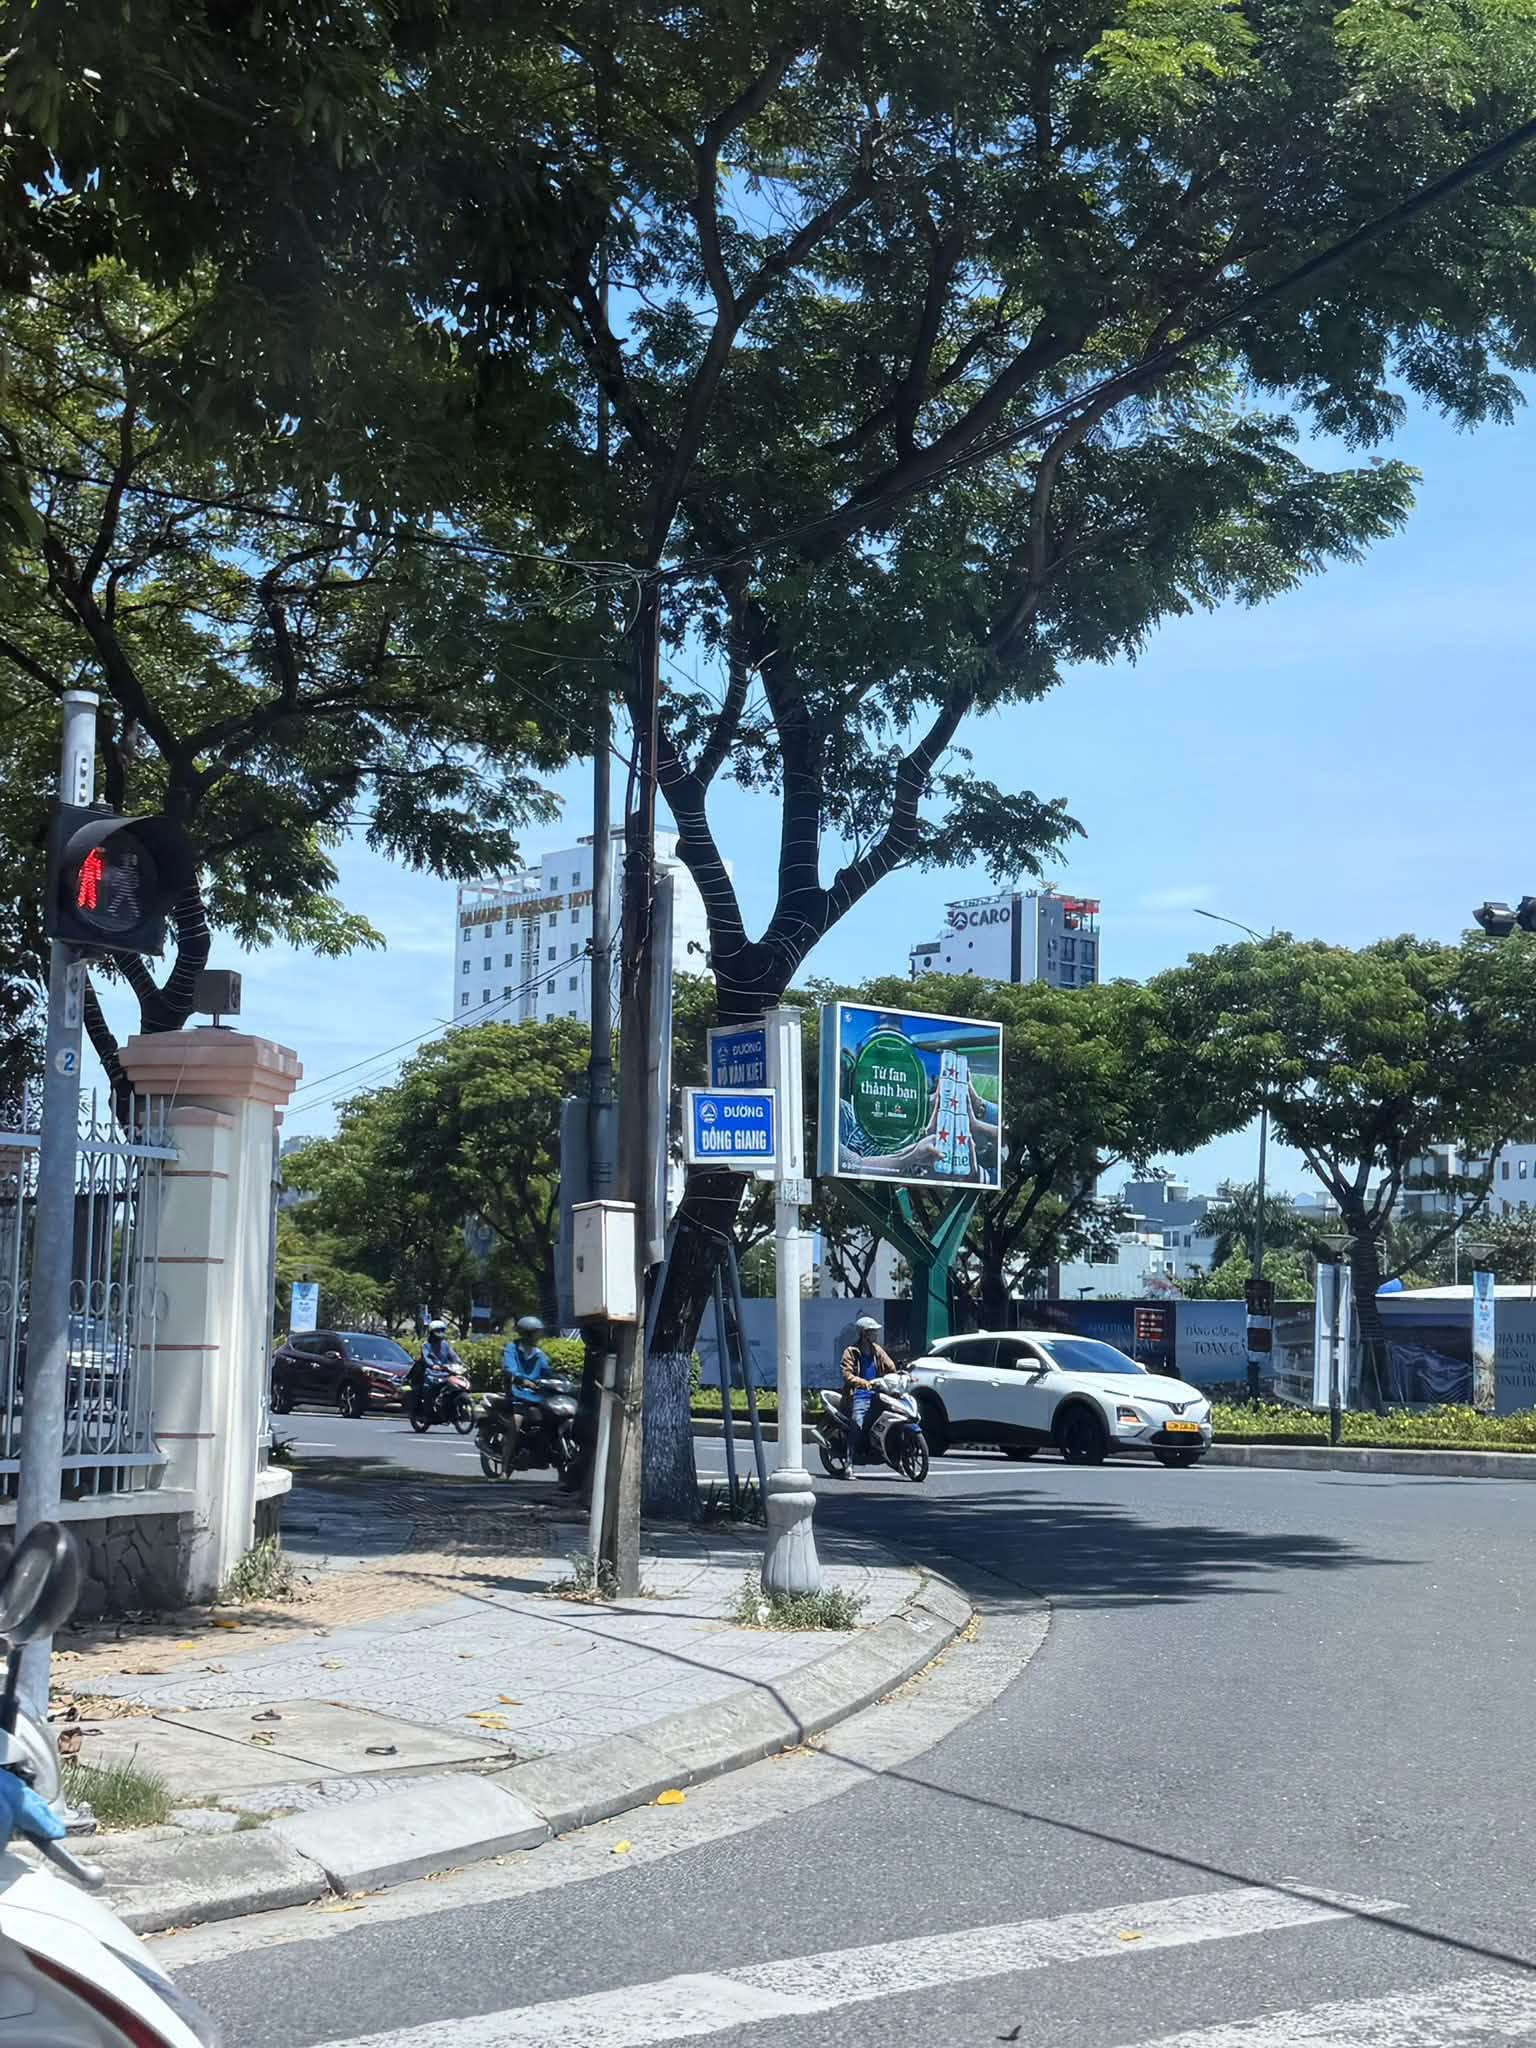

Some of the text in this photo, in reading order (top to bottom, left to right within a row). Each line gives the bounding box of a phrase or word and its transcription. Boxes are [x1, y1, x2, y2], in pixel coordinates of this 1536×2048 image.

[568, 890, 593, 909] HOT
[969, 908, 1010, 926] CARO
[63, 1052, 75, 1071] 2
[872, 1065, 906, 1082] Từ fan
[861, 1080, 917, 1102] thành bạn
[723, 1103, 764, 1118] ĐƯỜNG
[702, 1126, 767, 1150] ĐÔNG GIANG
